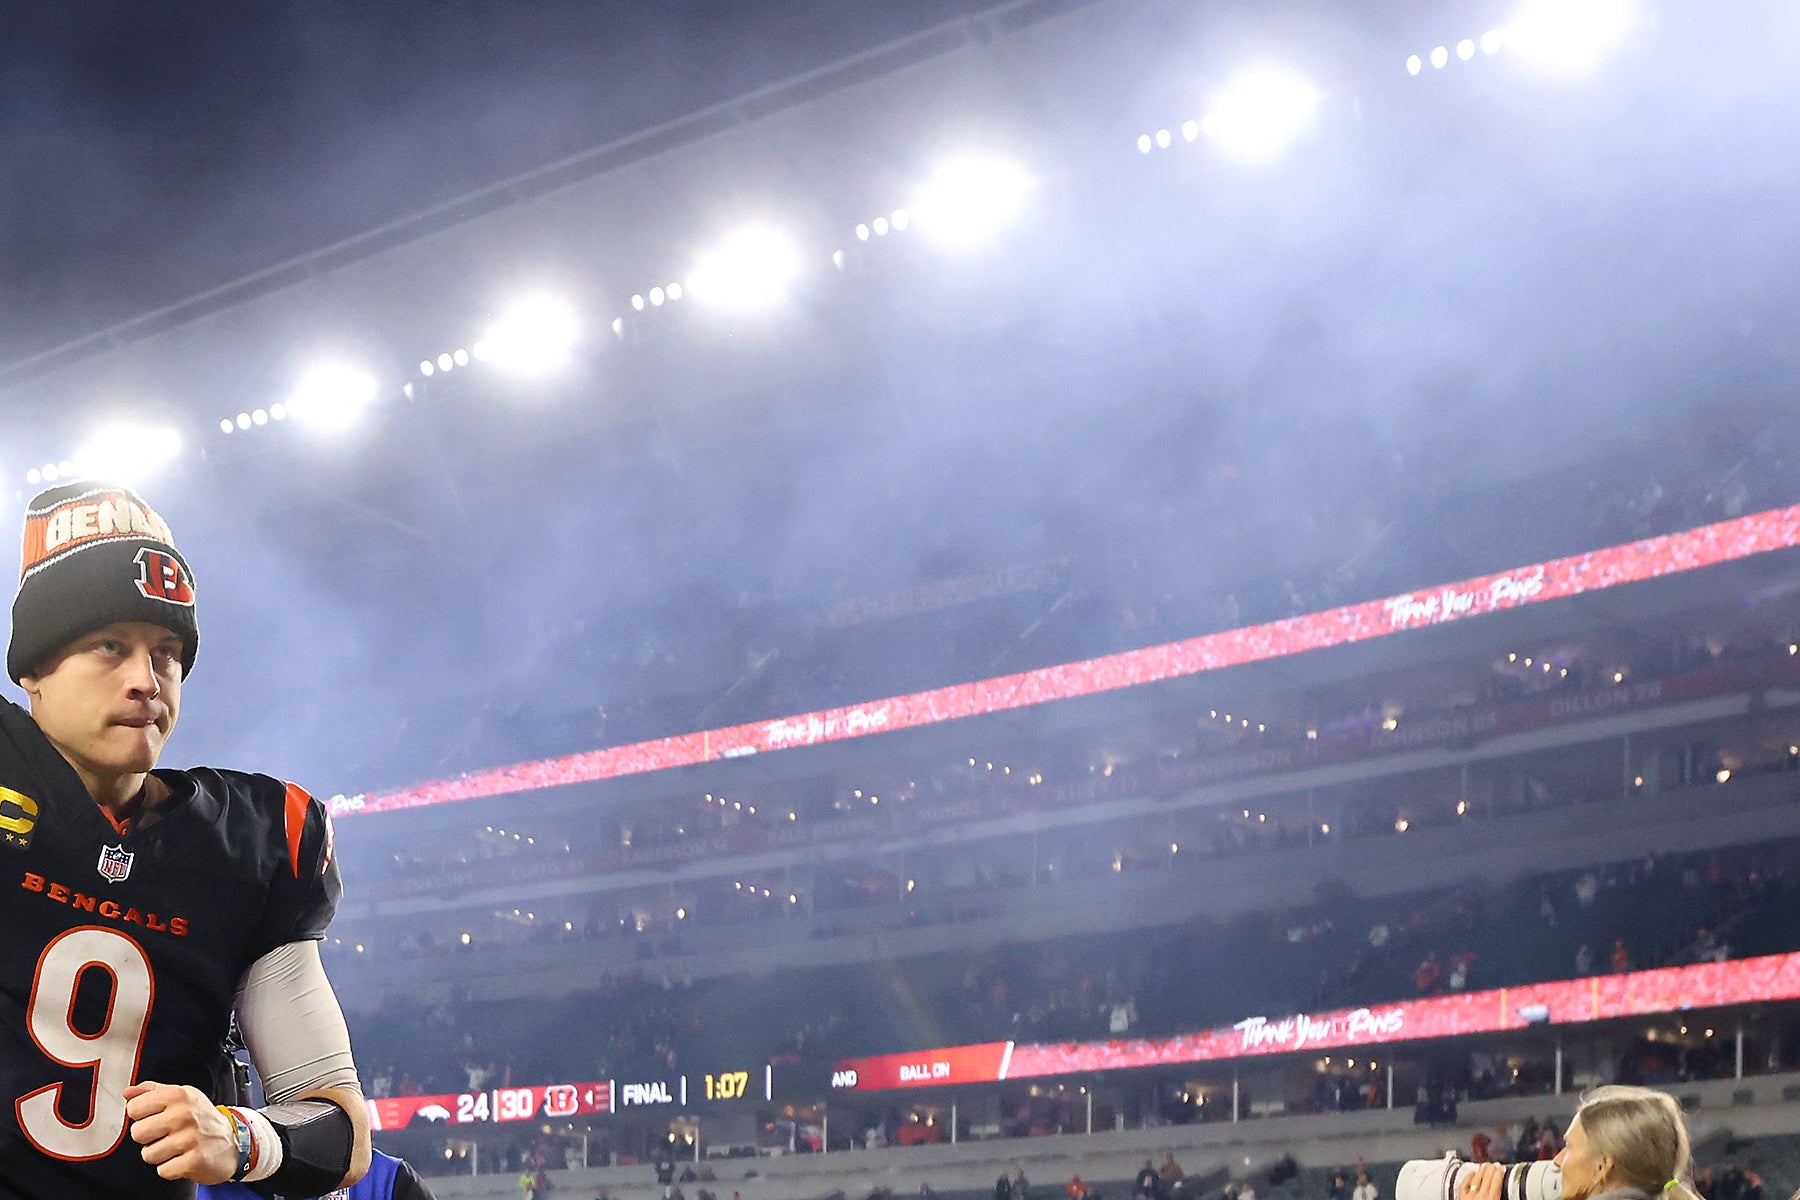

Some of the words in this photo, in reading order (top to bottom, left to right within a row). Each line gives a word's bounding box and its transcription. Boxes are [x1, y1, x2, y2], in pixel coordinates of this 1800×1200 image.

[20, 871, 190, 938] BENGALS
[14, 924, 156, 1162] 9
[457, 1091, 490, 1124] 24
[500, 1088, 534, 1120] 30
[622, 1081, 673, 1107] FINAL
[704, 1071, 749, 1100] 1:07
[831, 1069, 858, 1088] AND
[900, 1064, 931, 1082] BALL
[932, 1062, 951, 1078] ON
